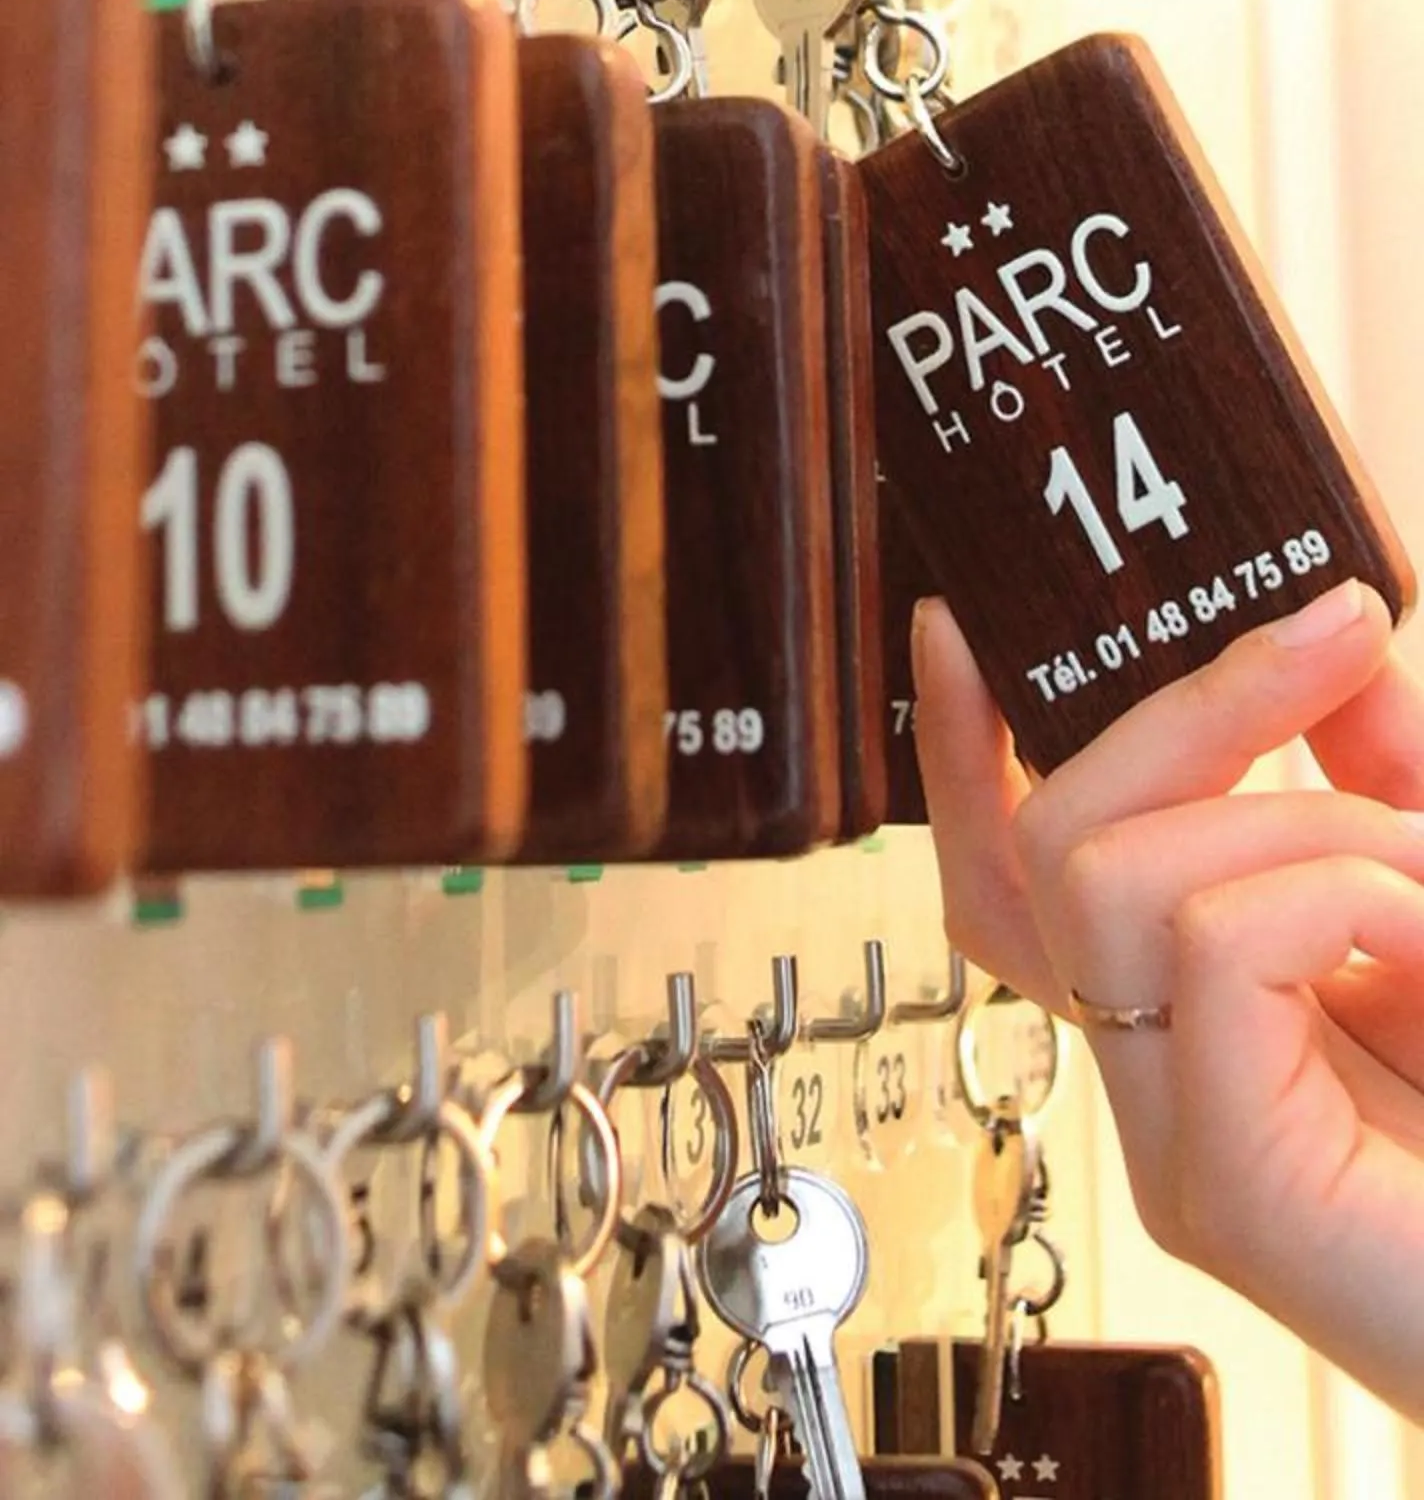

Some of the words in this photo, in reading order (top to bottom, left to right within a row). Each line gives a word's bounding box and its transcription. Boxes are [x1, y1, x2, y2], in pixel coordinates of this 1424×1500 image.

[136, 187, 384, 337] ARC
[885, 212, 1154, 415] PARC
[930, 304, 1183, 453] HÔTEL
[139, 441, 295, 633] 10
[1043, 410, 1191, 576] 14
[1027, 650, 1098, 702] Tél.
[1095, 623, 1141, 670] 01
[1146, 600, 1189, 644] 48
[1187, 575, 1237, 623] 84
[1233, 551, 1284, 599] 75
[1282, 529, 1332, 576] 89
[712, 706, 765, 756] 89
[791, 1072, 824, 1151] 32
[876, 1052, 907, 1125] 33
